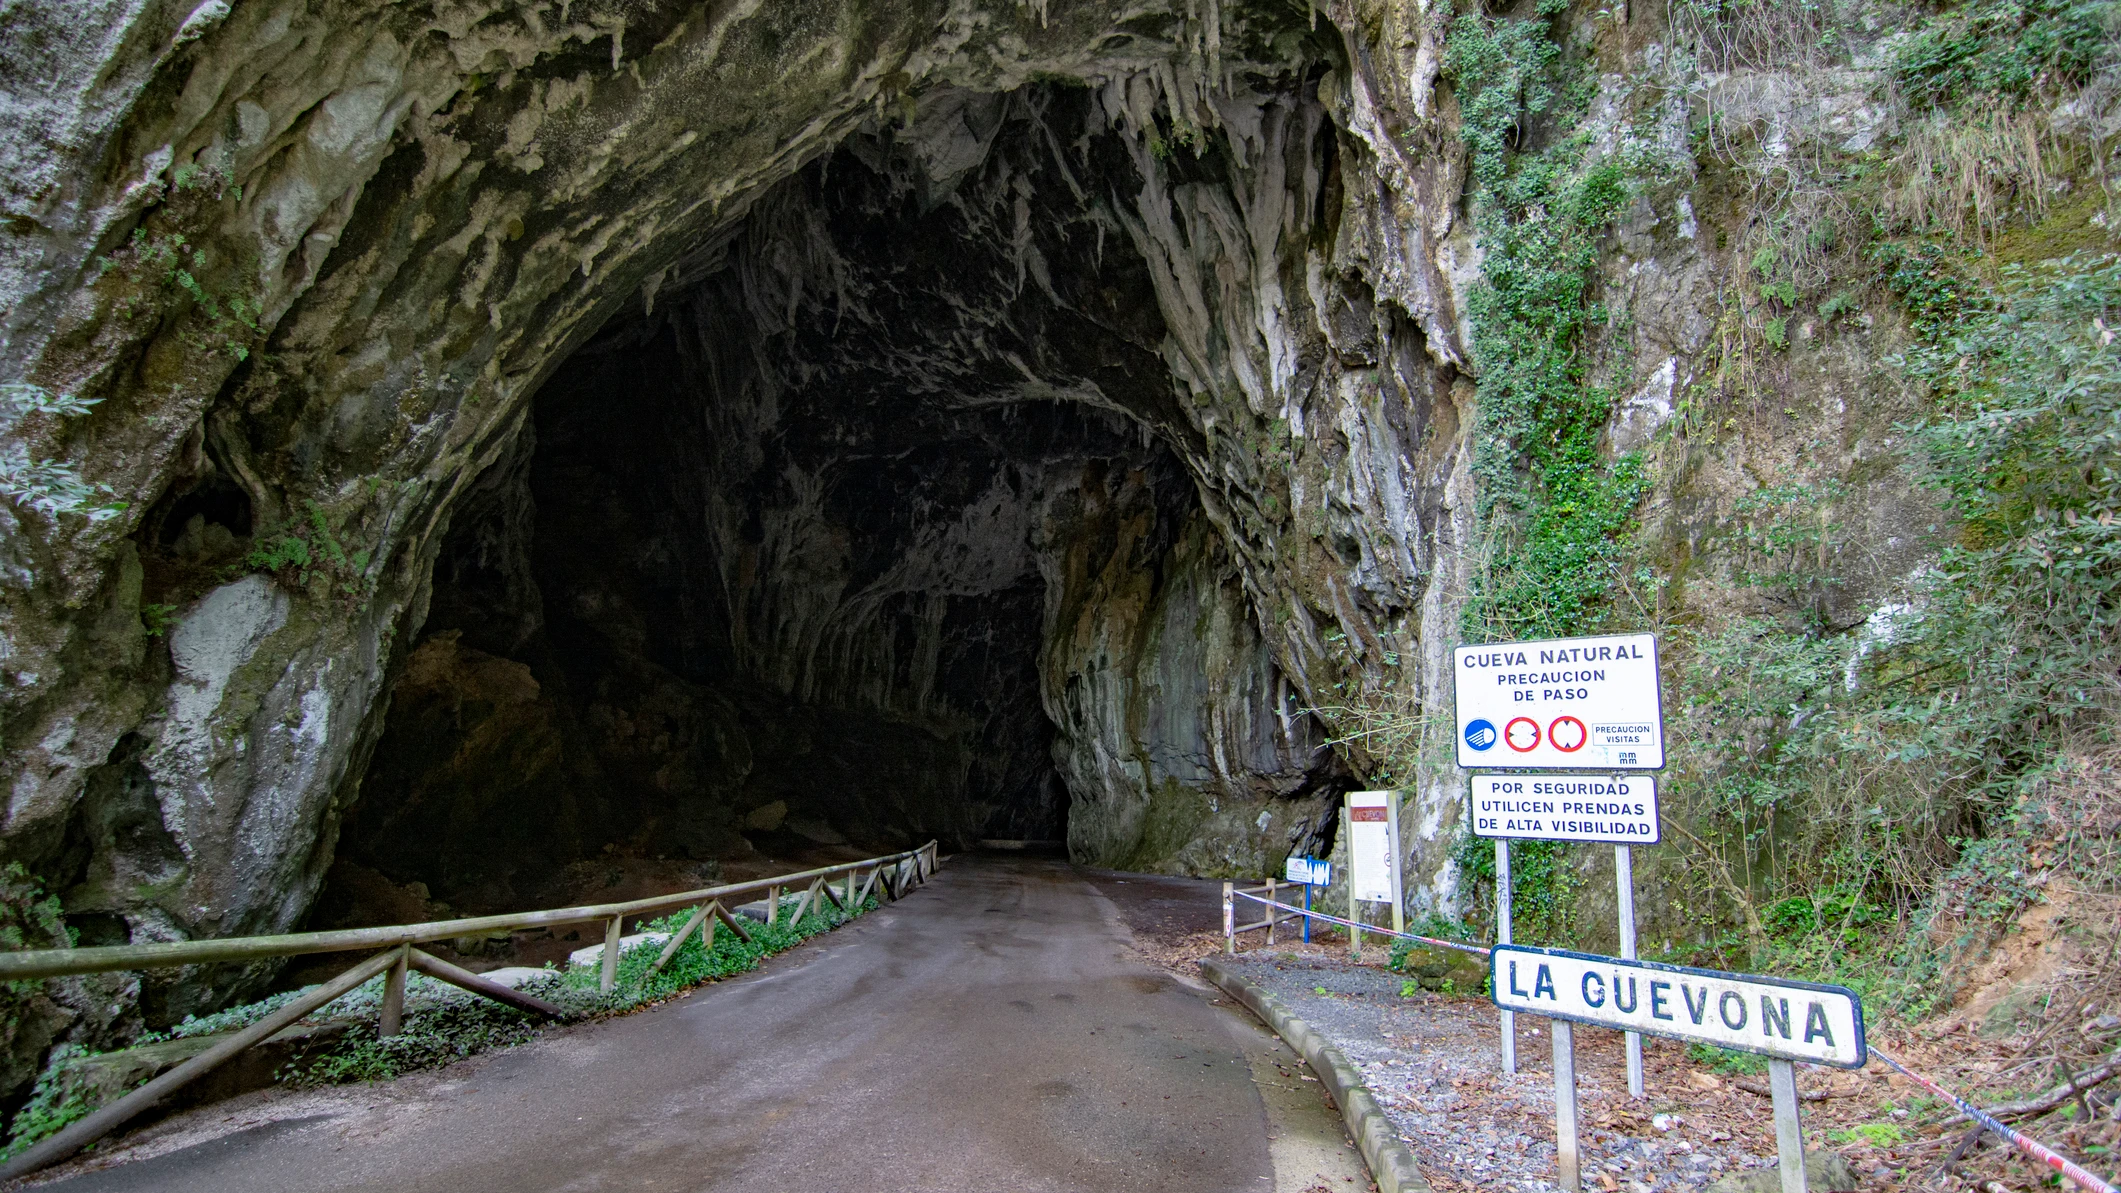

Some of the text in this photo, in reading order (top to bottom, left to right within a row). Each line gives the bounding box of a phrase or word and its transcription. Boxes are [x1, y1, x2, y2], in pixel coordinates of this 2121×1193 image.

[1464, 645, 1643, 668] CUEVA NATURAL
[1498, 670, 1604, 685] PRECAUCION
[1515, 688, 1587, 701] DE PASO
[1492, 783, 1629, 795] POR SEGURIDAD
[1482, 801, 1644, 815] UTILICEN PRENDAS
[1479, 819, 1650, 834] DE ALTA VISIBILIDAD
[1510, 961, 1556, 1001] LA
